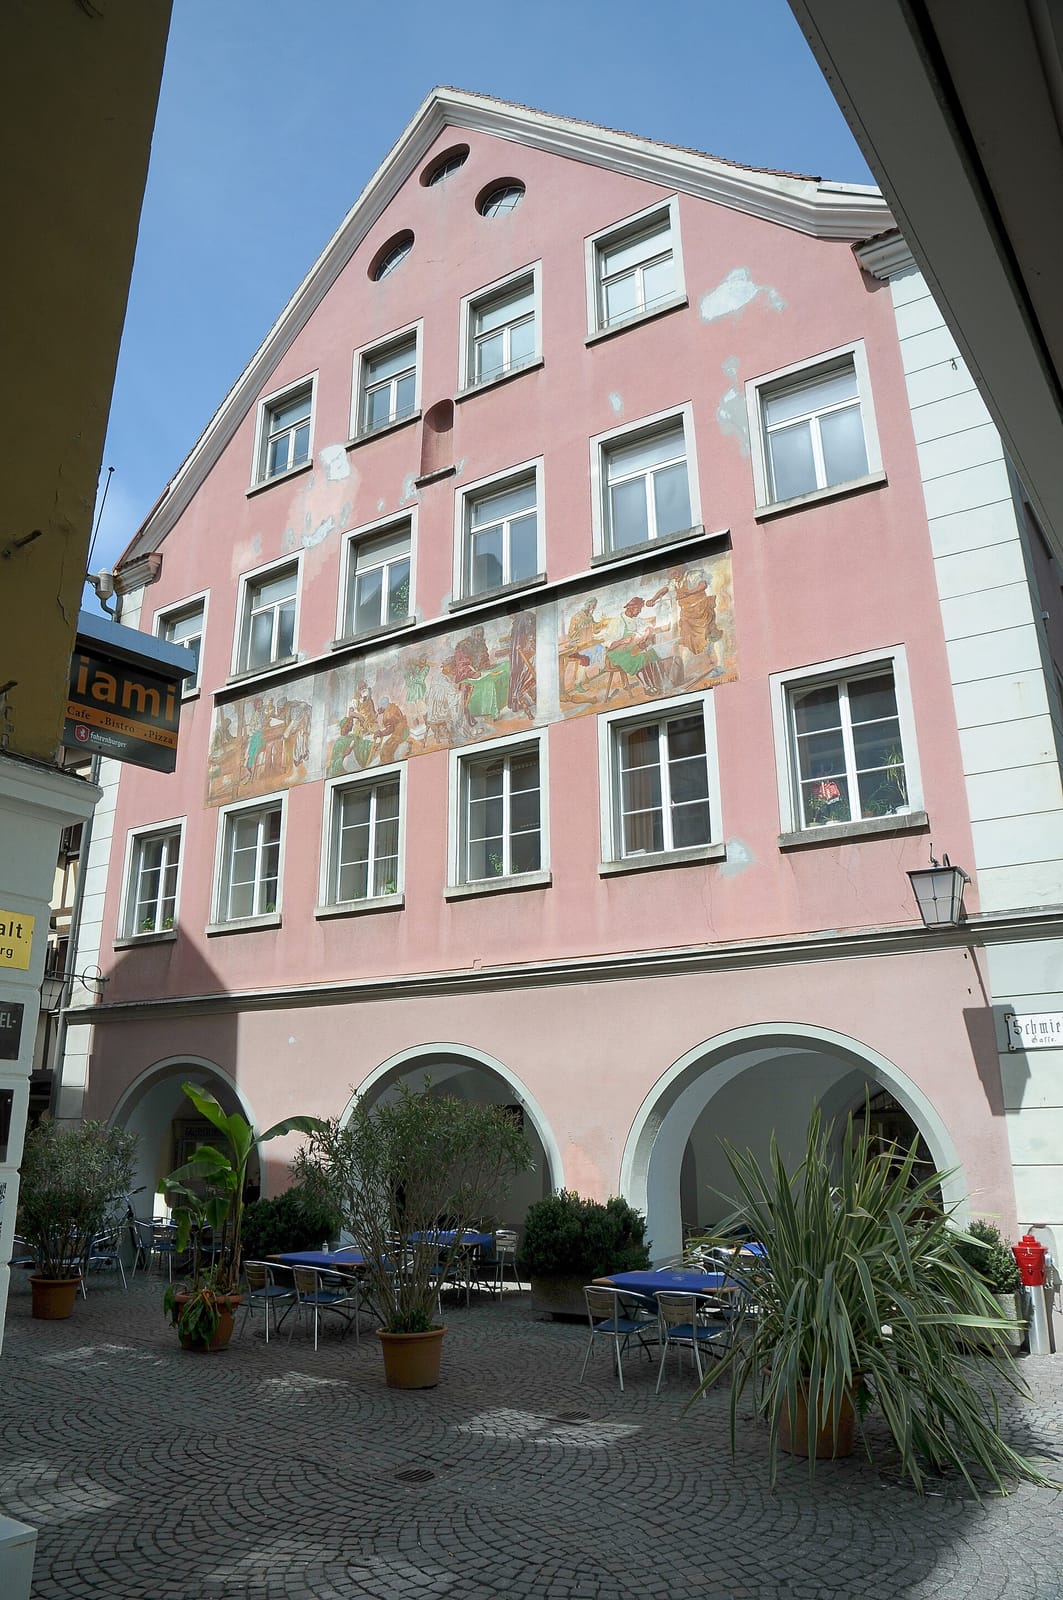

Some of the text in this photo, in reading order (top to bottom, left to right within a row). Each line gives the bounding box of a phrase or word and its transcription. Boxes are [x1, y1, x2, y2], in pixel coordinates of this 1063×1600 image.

[77, 656, 176, 721] iami
[0, 921, 23, 939] alt
[1013, 1016, 1063, 1036] Schmie
